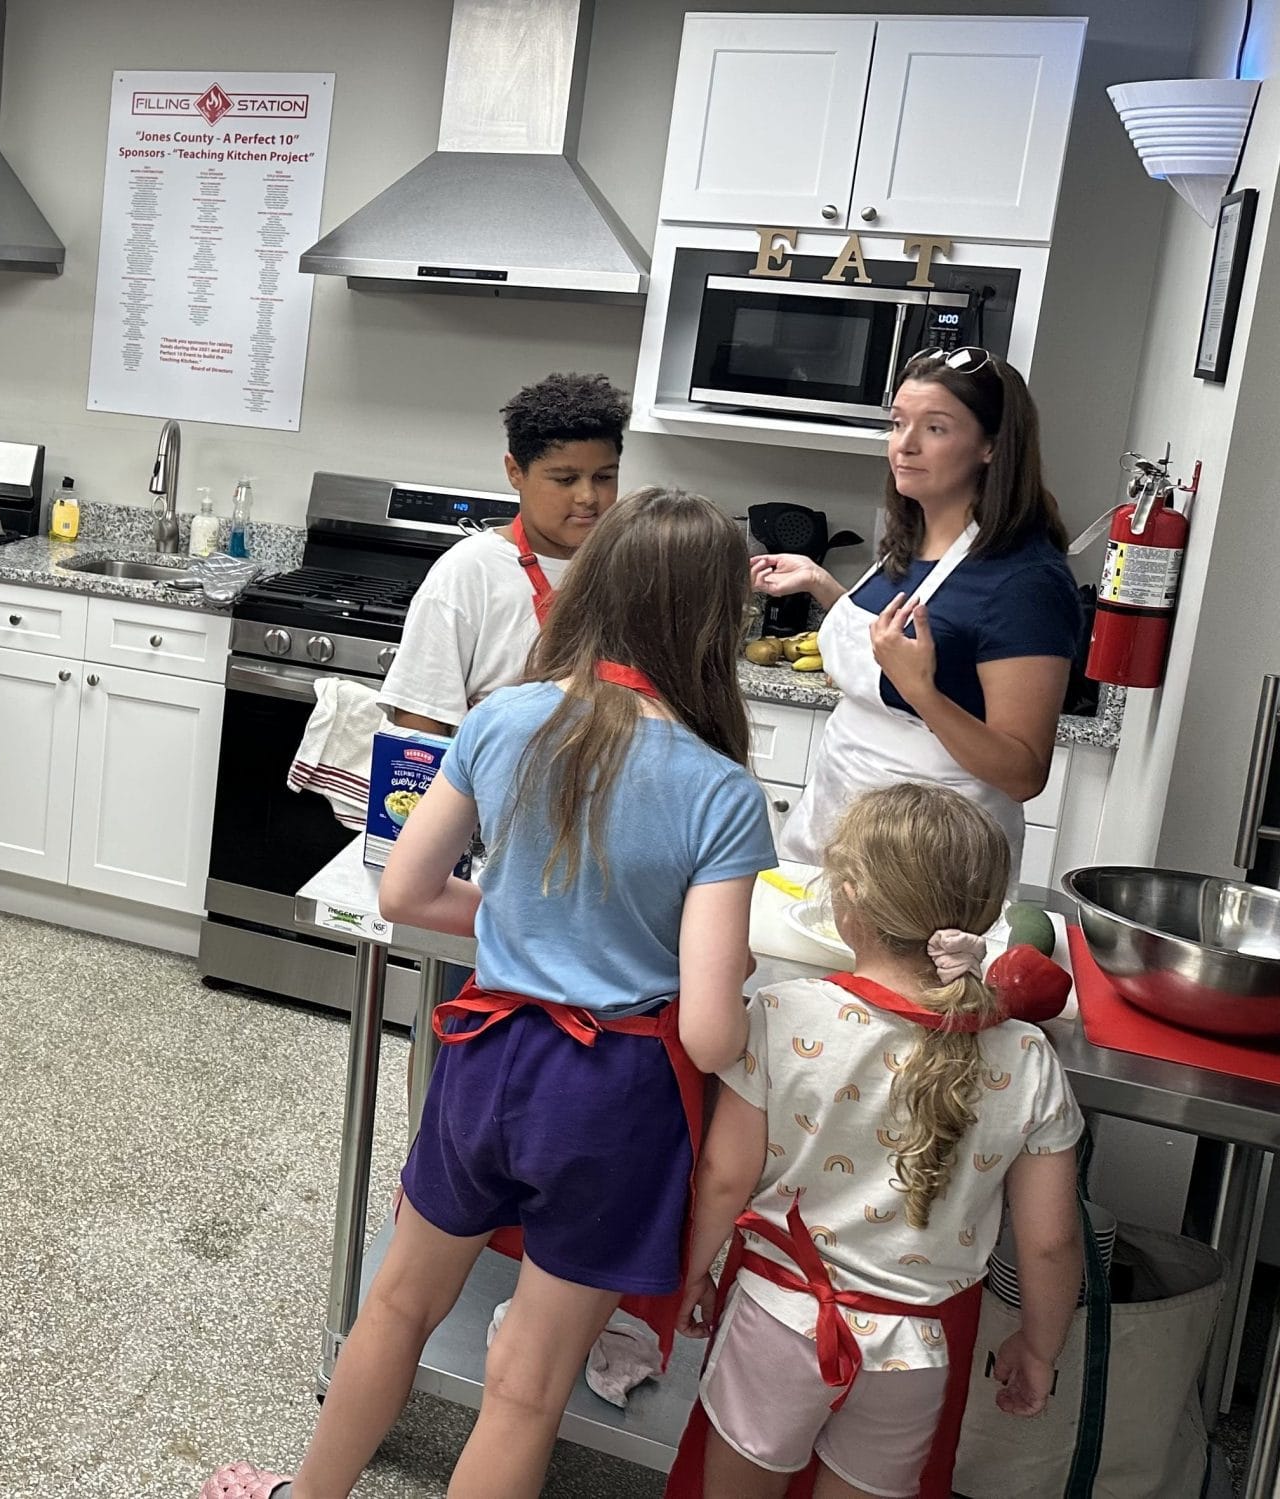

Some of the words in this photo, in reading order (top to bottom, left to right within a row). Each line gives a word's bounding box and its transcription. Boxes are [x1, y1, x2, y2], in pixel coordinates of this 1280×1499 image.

[136, 98, 190, 110] FILLING
[237, 100, 305, 112] STATION
[136, 131, 171, 142] “Jones
[173, 132, 214, 145] County
[223, 133, 231, 144] A
[234, 133, 276, 145] Perfect
[119, 147, 165, 159] Sponsors
[172, 148, 224, 163] “Teaching
[227, 150, 267, 161] Kitchen
[270, 151, 315, 165] Project”
[391, 777, 418, 791] every
[417, 779, 431, 790] da
[327, 906, 365, 920] REGENCY
[373, 922, 386, 932] NSF
